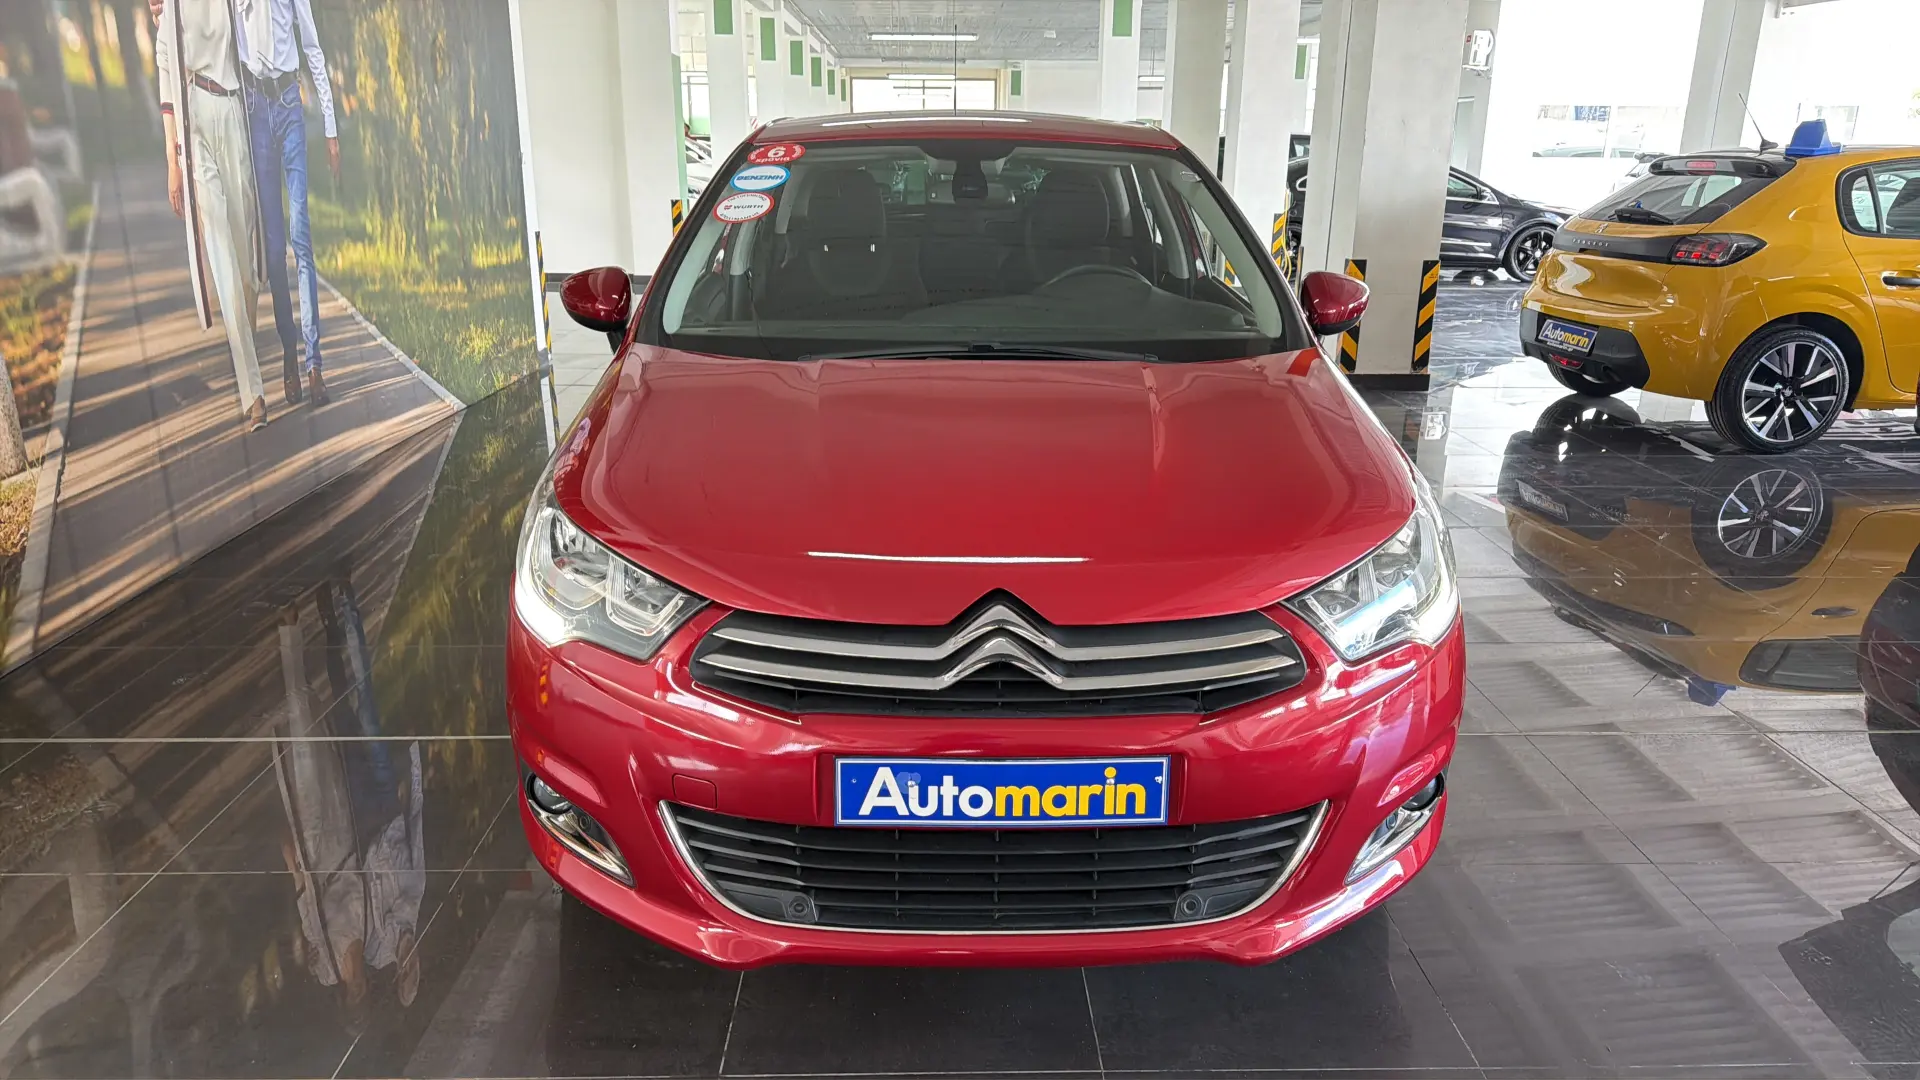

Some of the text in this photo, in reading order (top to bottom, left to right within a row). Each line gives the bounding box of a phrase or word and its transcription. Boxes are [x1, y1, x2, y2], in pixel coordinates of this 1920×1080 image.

[768, 146, 787, 158] 6
[1542, 323, 1589, 348] Automarin
[858, 766, 1147, 818] Automarin
